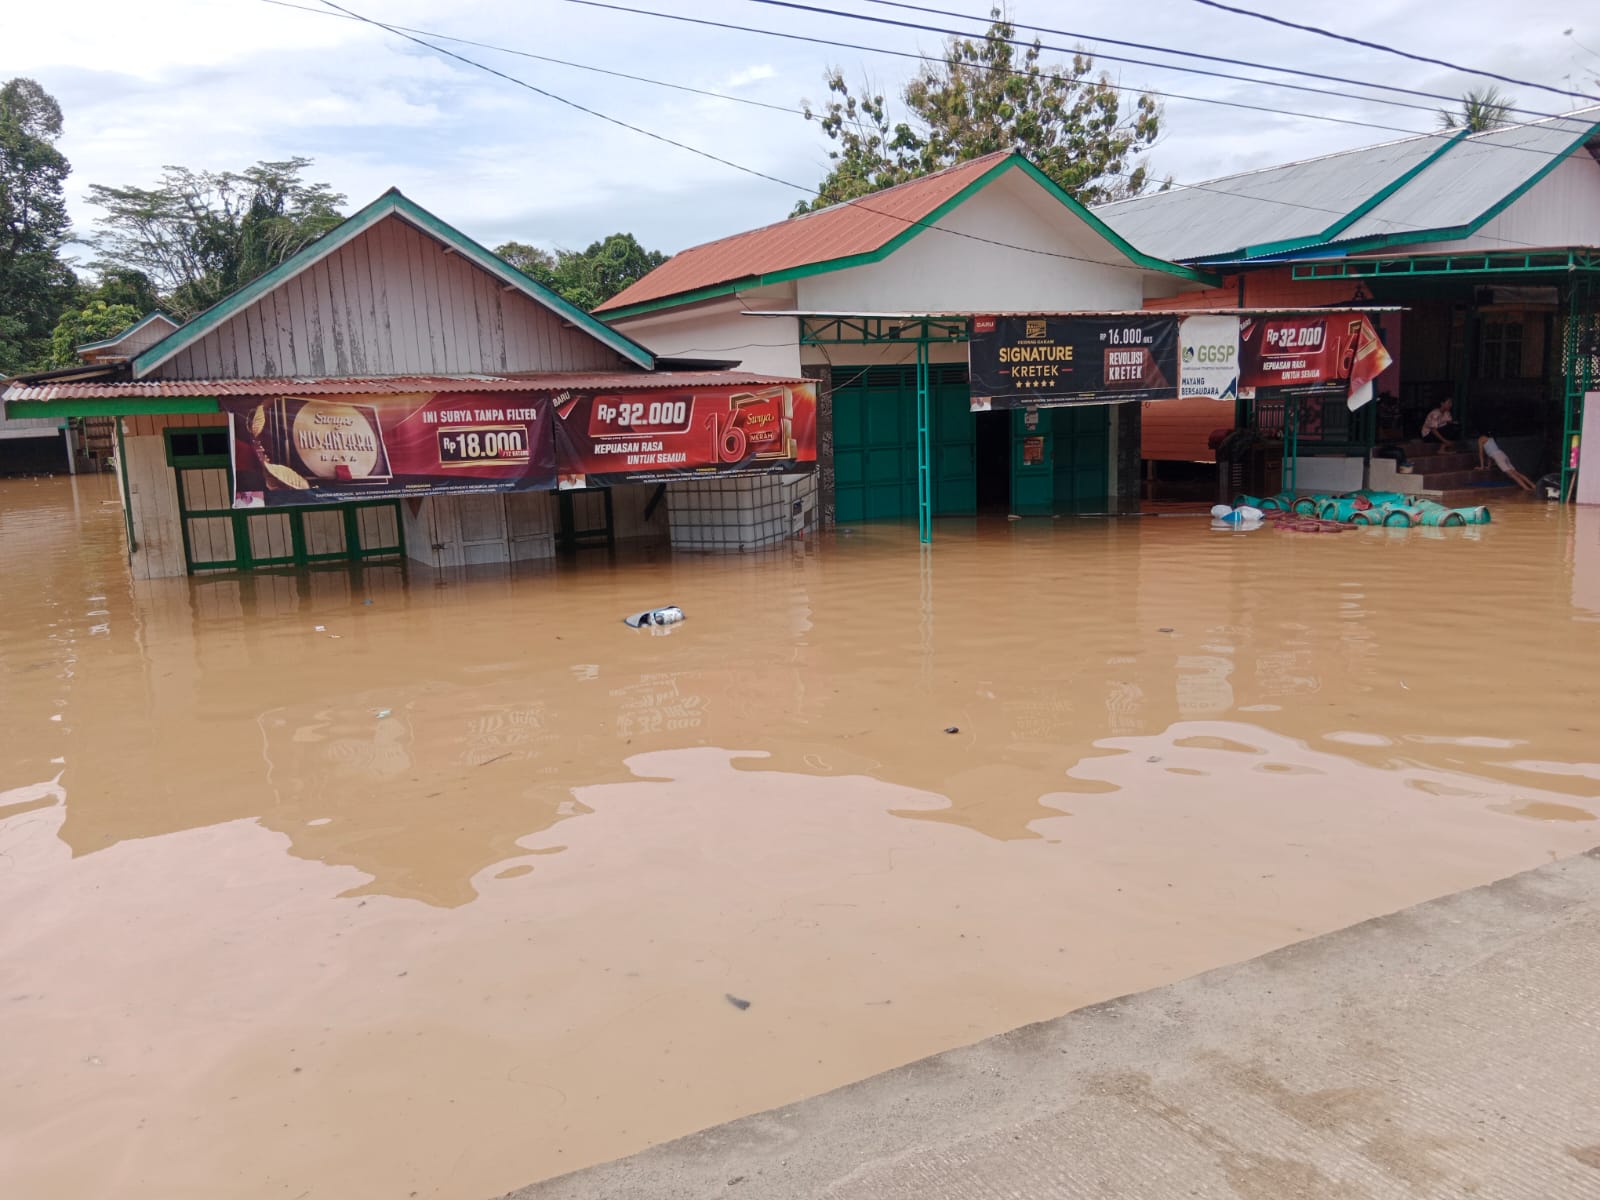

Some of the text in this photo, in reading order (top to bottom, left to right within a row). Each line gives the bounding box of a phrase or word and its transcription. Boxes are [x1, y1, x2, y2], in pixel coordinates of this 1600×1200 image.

[1108, 328, 1142, 345] 16.000
[999, 346, 1073, 363] SIGNATURE
[1109, 351, 1143, 366] REVOLUSI
[1197, 344, 1235, 363] GGSP
[1011, 365, 1059, 377] KRETEK
[1109, 366, 1143, 380] KRETEK
[1181, 377, 1205, 386] MAYANG
[1181, 386, 1220, 396] BERSAUDARA
[552, 391, 571, 407] BARU
[422, 408, 537, 424] INI SURYA TANPA FILTER
[746, 412, 775, 427] Surya
[297, 430, 375, 452] NUSANTARA
[703, 408, 747, 464] 16
[594, 441, 663, 455] KEPUASAN RASA
[627, 452, 687, 465] UNTUK SEMUA
